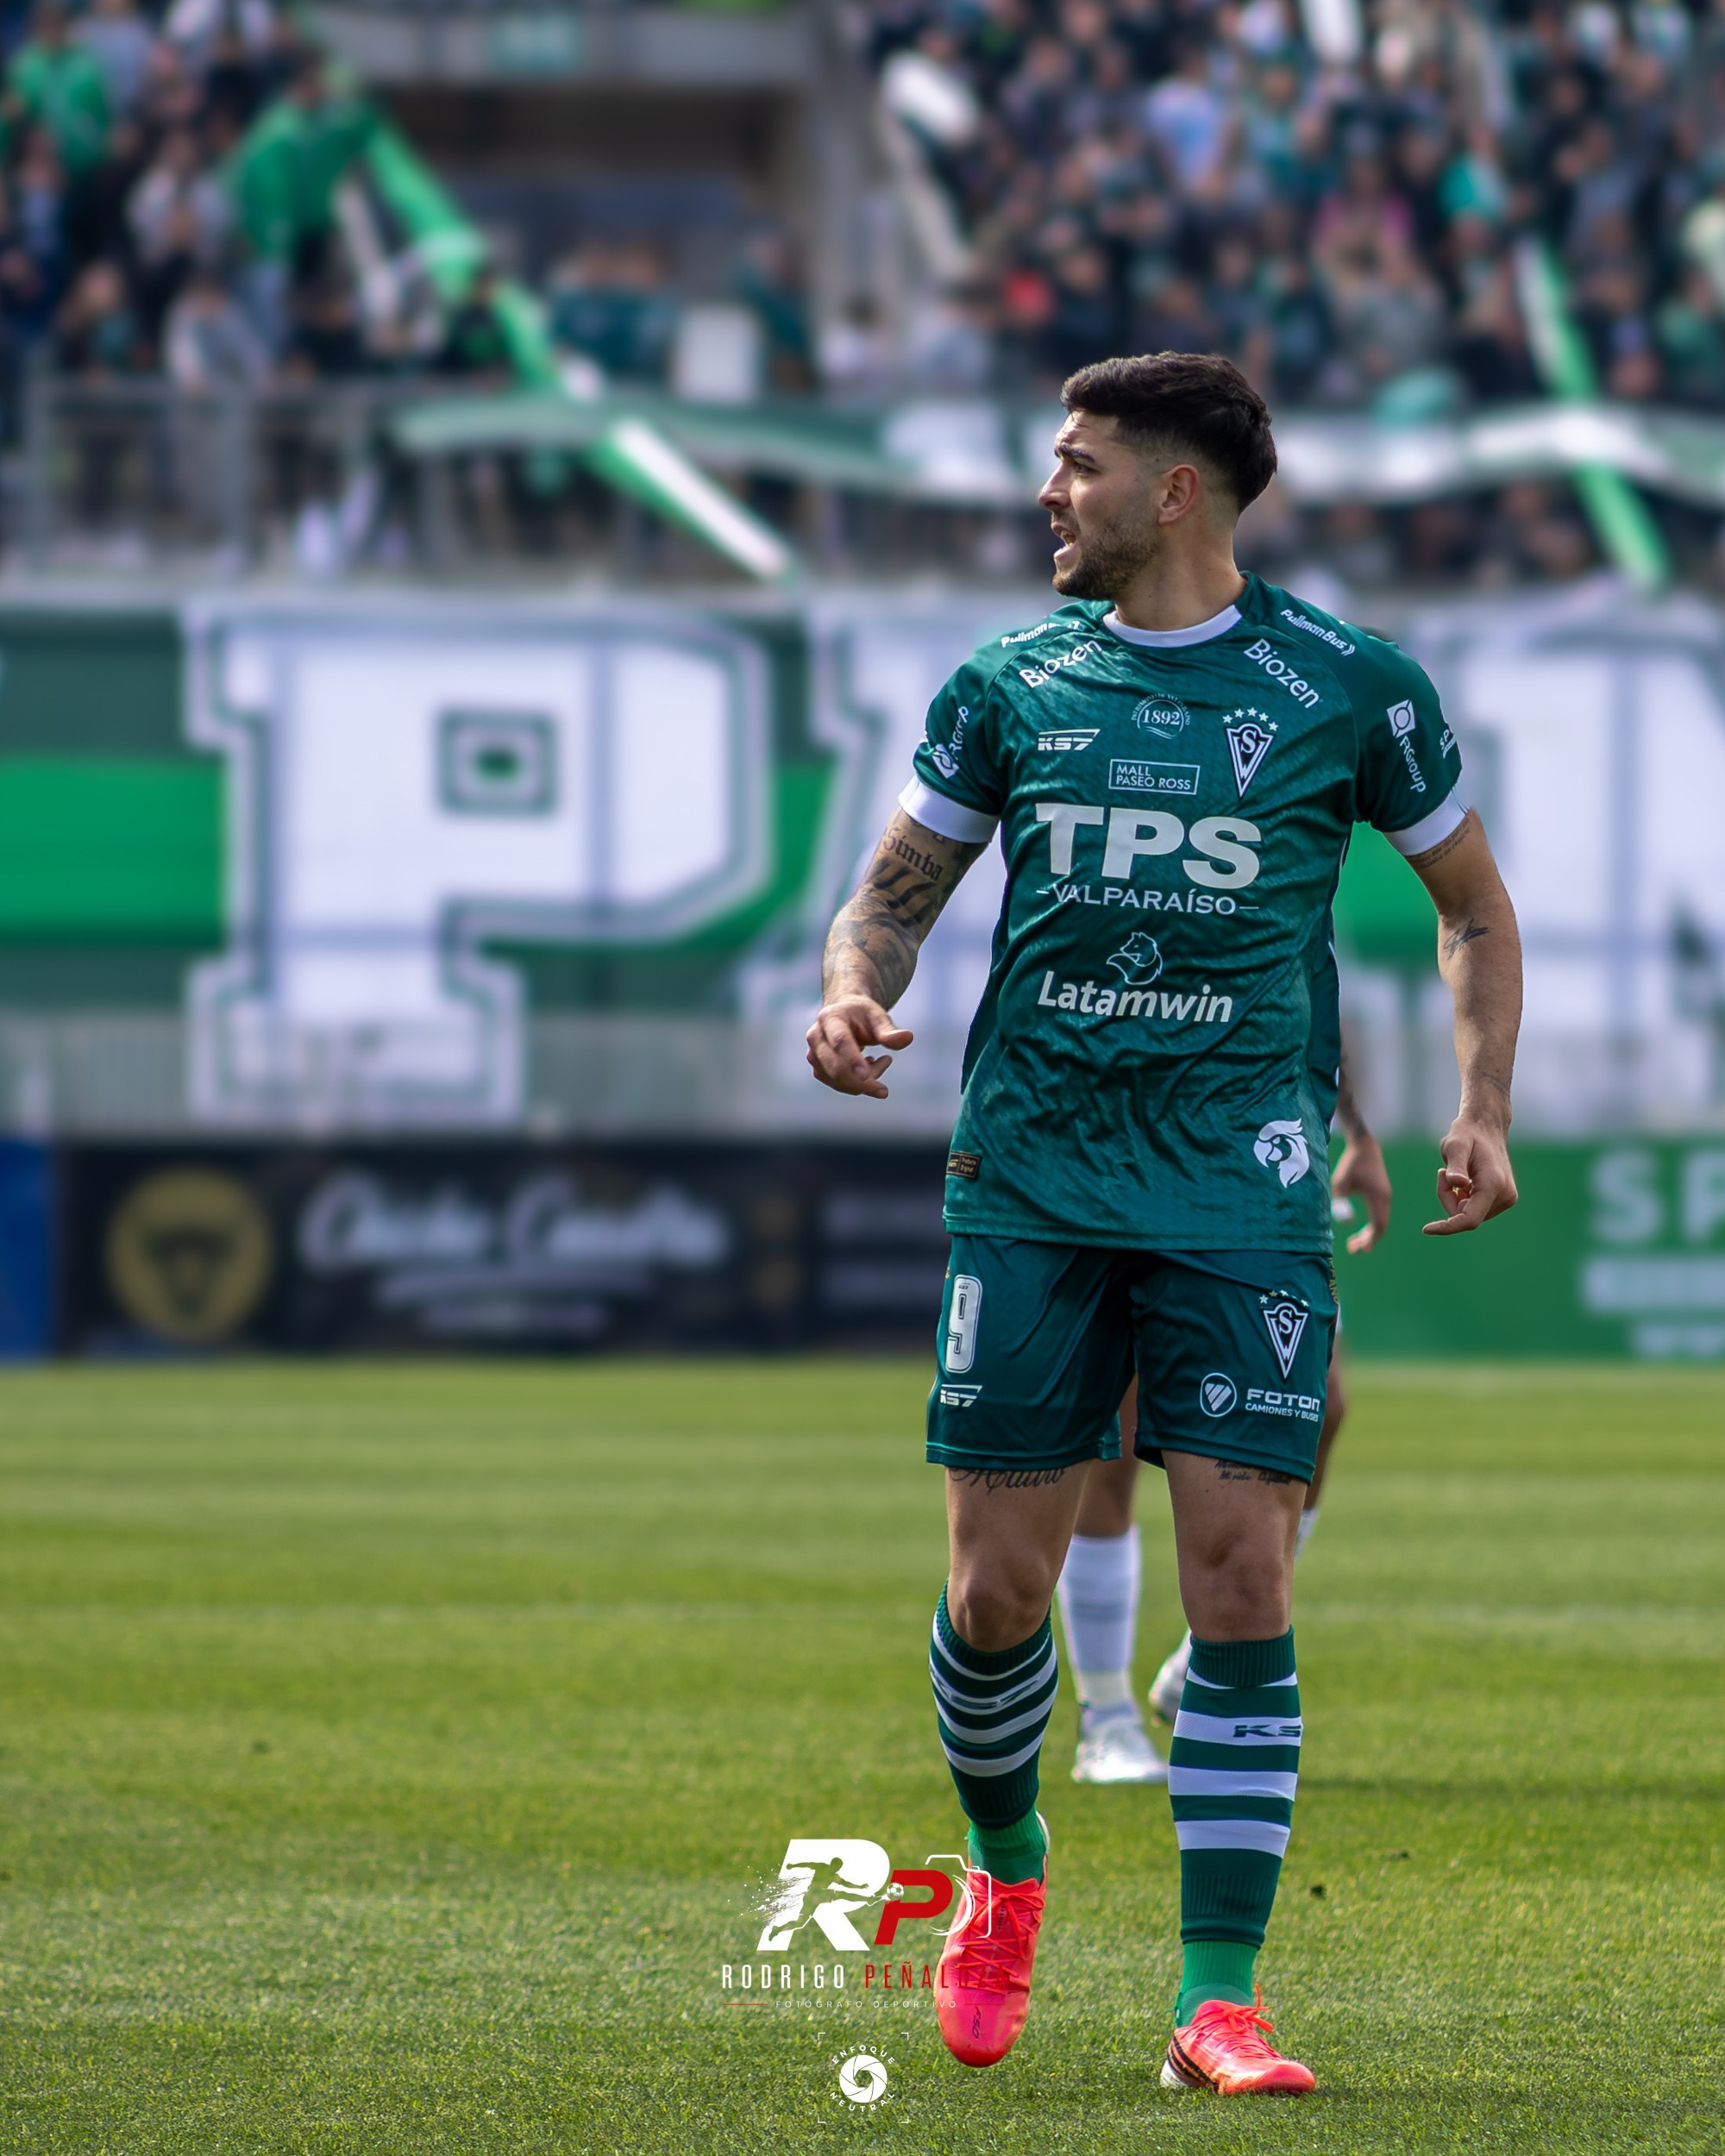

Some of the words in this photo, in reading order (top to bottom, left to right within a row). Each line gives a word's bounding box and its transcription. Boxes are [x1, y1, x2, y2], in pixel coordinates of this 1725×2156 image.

[1019, 640, 1102, 688] Biozen
[1244, 638, 1320, 709] Biozen
[1142, 709, 1181, 725] 1892
[1038, 733, 1096, 751] KS7
[1399, 736, 1427, 793] RGroup
[1115, 775, 1156, 788] PASEO
[1158, 778, 1191, 791] ROSS
[1116, 764, 1151, 776] MALL
[883, 827, 944, 881] Simba
[1035, 803, 1262, 889] TPS
[1052, 883, 1237, 916] VALPARAÍSO
[1038, 970, 1233, 1023] Latamwin
[945, 1274, 982, 1373] 9
[1245, 1402, 1293, 1417] CAMIONES
[1295, 1409, 1301, 1418] Y
[1301, 1411, 1319, 1422] BUSES
